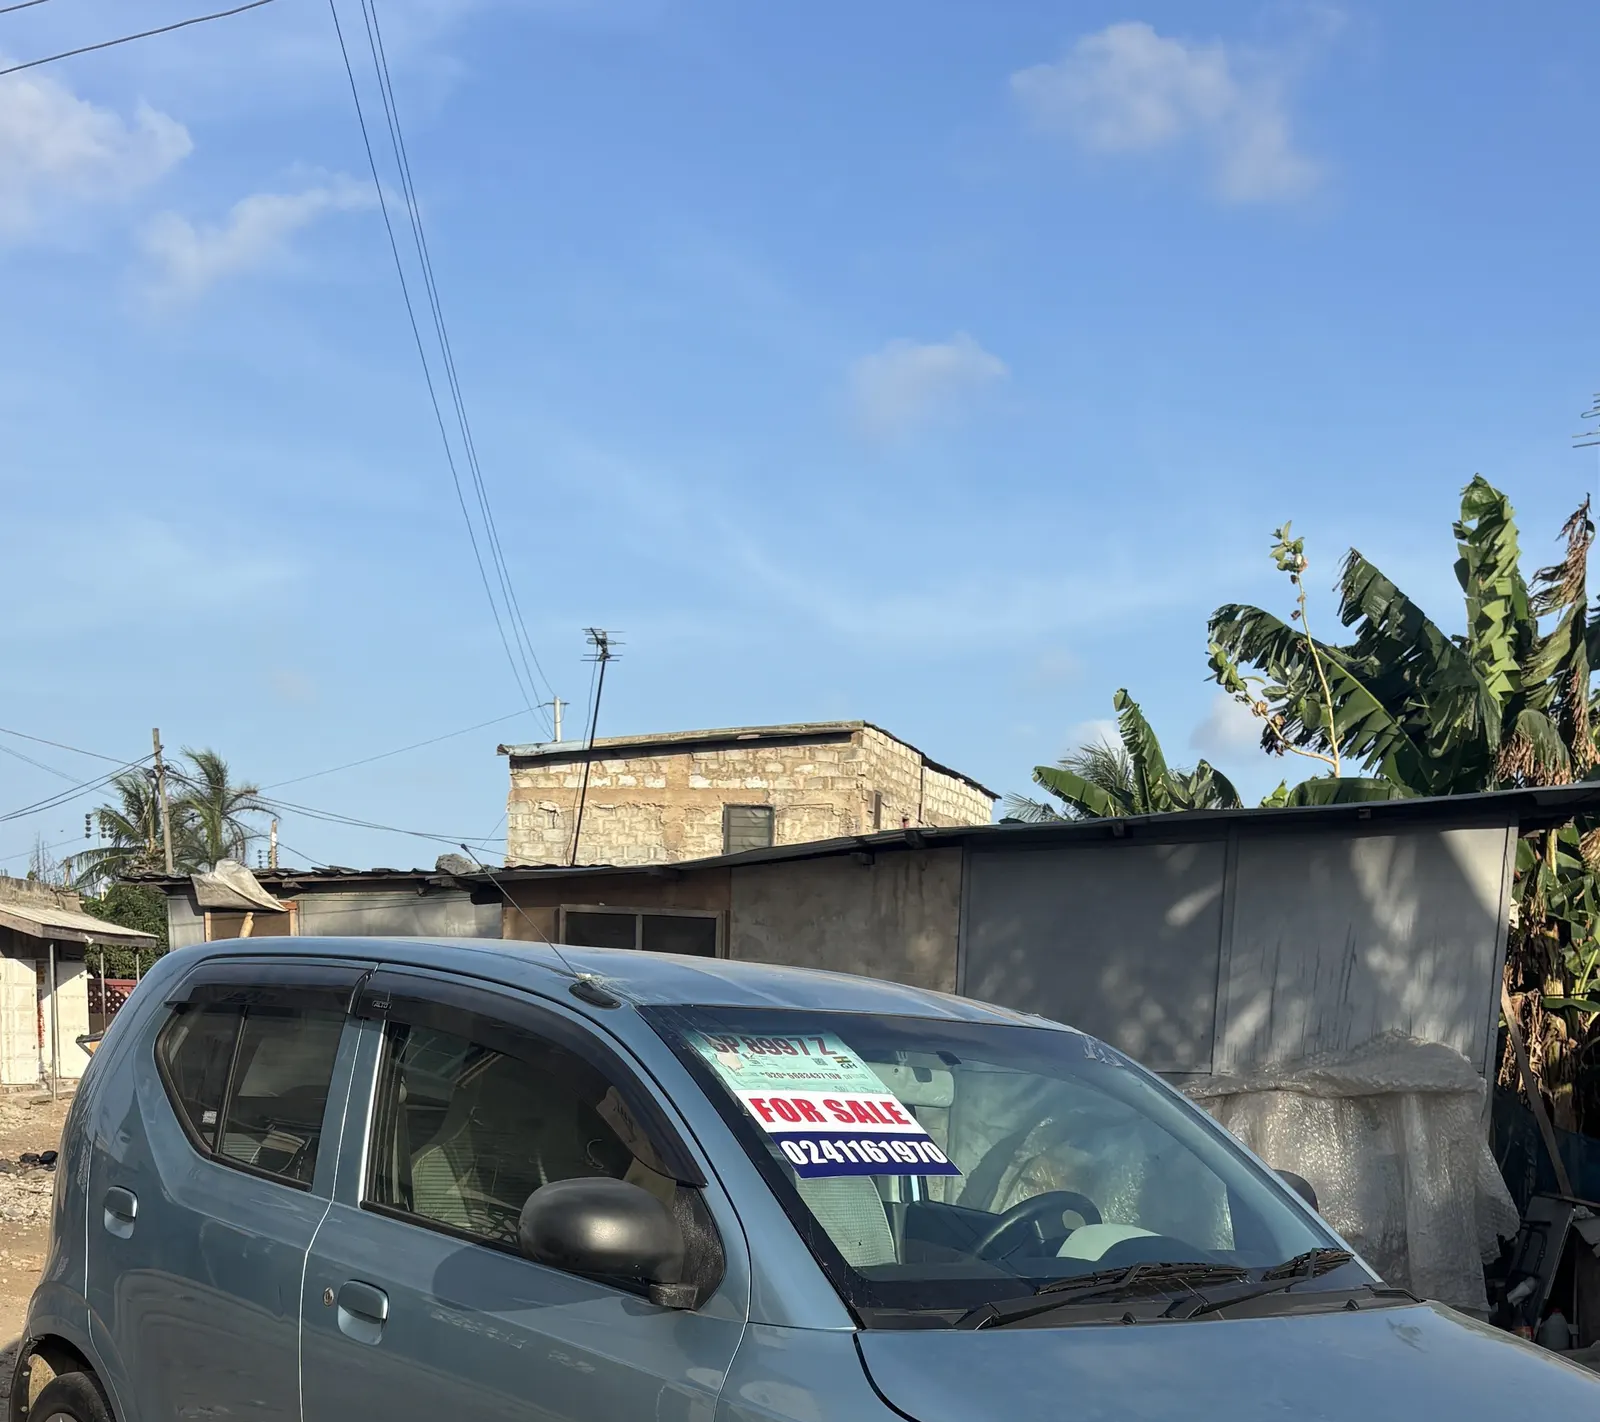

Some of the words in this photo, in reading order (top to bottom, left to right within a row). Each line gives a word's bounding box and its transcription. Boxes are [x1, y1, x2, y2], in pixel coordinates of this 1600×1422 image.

[740, 1036, 811, 1056] 8997
[808, 1037, 837, 1055] Z
[749, 1098, 825, 1123] FOR
[826, 1098, 911, 1125] SALE
[780, 1140, 948, 1165] 0241161970
